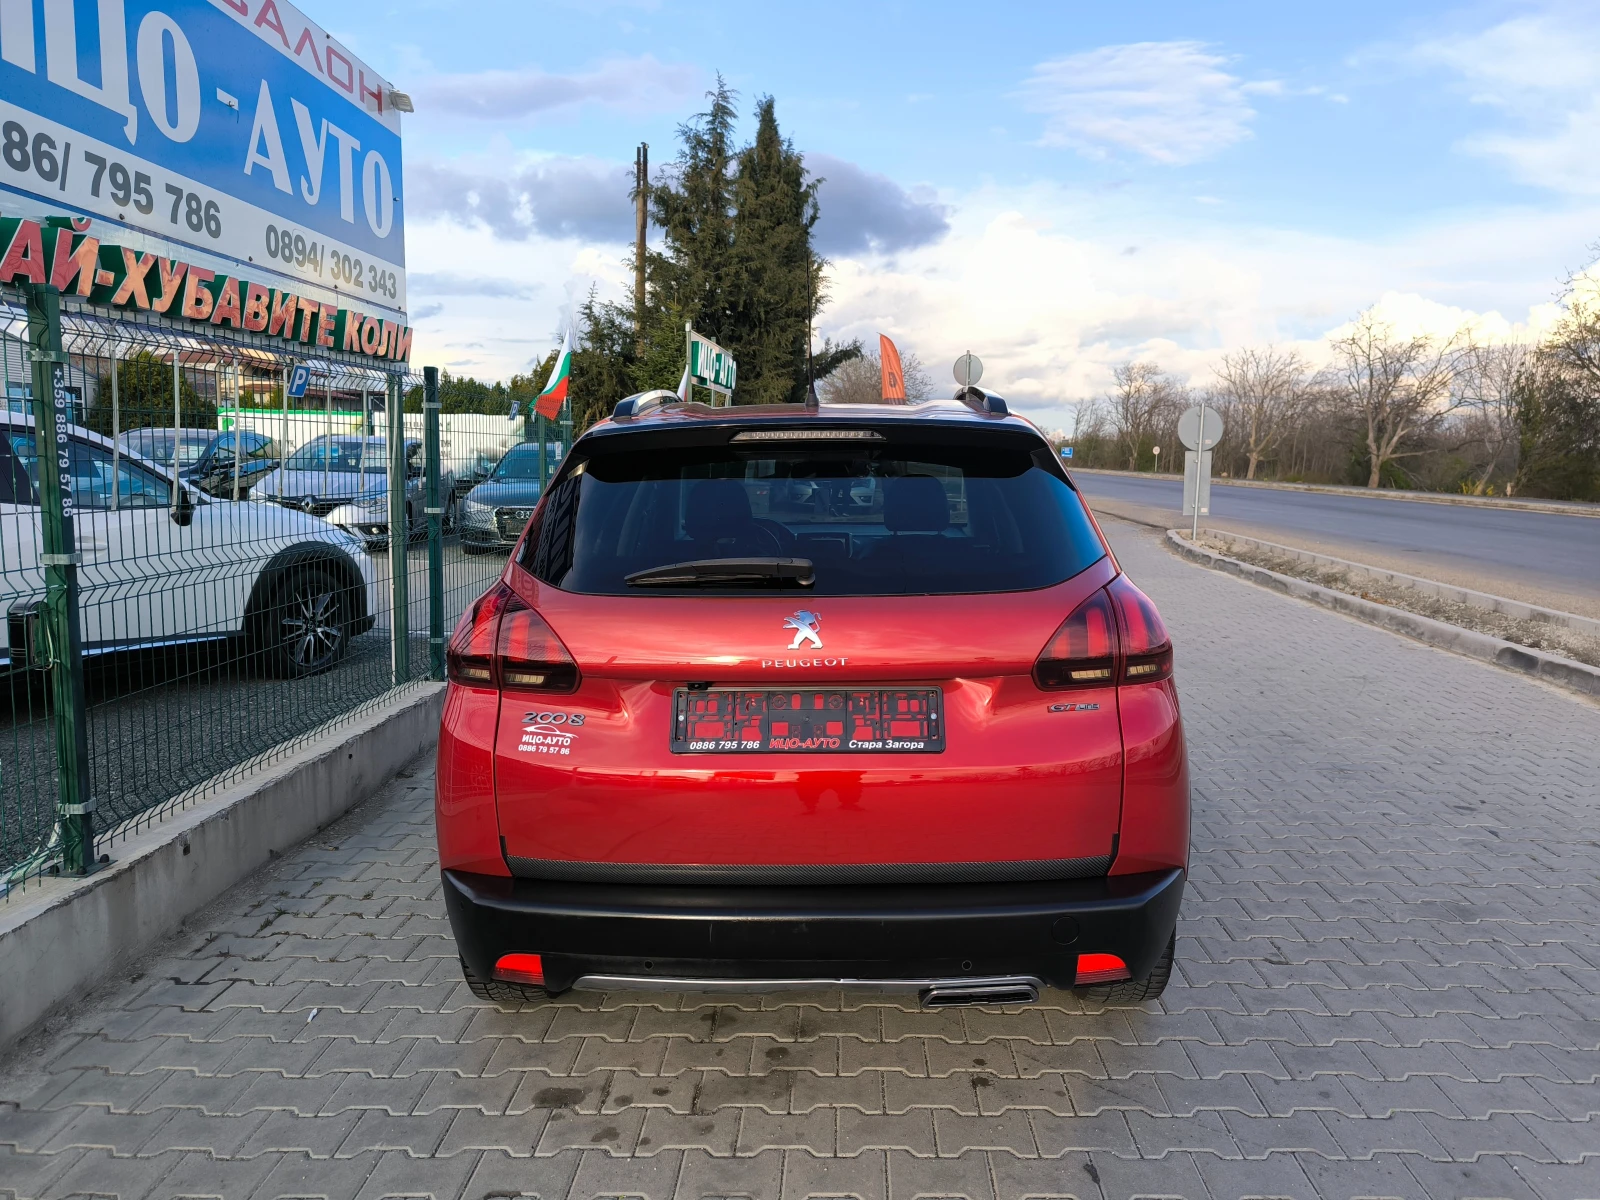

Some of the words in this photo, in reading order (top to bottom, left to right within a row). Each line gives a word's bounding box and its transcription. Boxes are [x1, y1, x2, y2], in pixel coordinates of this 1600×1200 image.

[222, 0, 383, 116] АЛОН
[84, 150, 154, 215] 795
[165, 182, 222, 239] 786
[265, 224, 325, 278] 0894/
[330, 250, 364, 289] 302
[368, 264, 397, 300] 343
[343, 309, 413, 363] КОЛИ
[697, 341, 737, 390] ИЦО-АУТО
[53, 368, 66, 408] +359
[56, 413, 68, 443] 886
[57, 448, 70, 468] 79
[60, 473, 72, 490] 57
[62, 498, 73, 517] 86
[761, 657, 849, 669] PEUGEOT
[521, 711, 585, 726] 2008
[518, 744, 536, 752] 0886
[538, 745, 548, 753] 79
[548, 746, 559, 754] 57
[559, 747, 570, 755] 86
[521, 734, 571, 746] ИЦО-АУТО
[689, 741, 716, 750] 0886
[718, 740, 738, 750] 795
[740, 740, 760, 750] 786
[769, 737, 841, 750] ИЦО-АУТО
[848, 739, 883, 750] Стара
[885, 739, 925, 750] Загора
